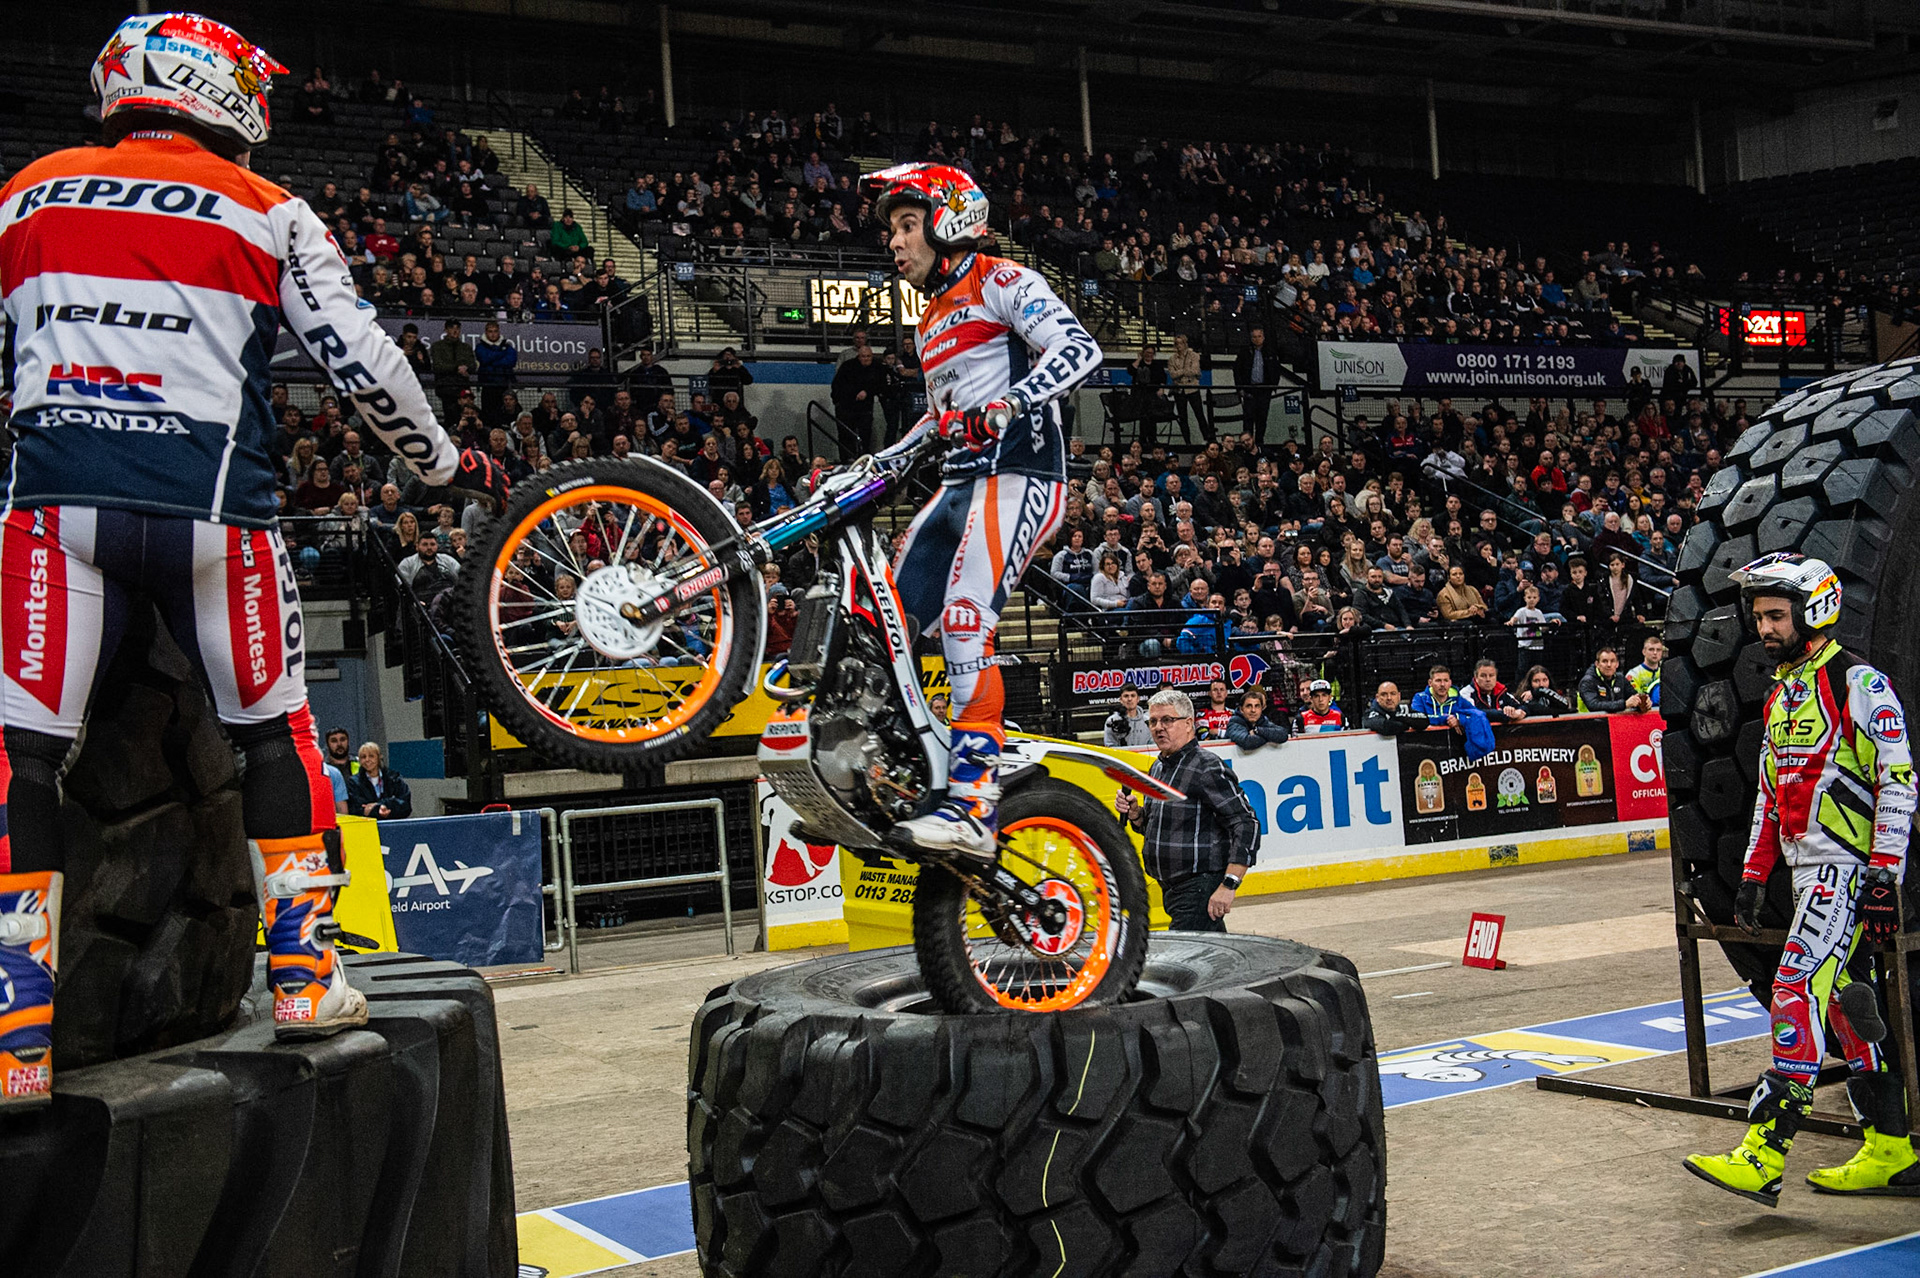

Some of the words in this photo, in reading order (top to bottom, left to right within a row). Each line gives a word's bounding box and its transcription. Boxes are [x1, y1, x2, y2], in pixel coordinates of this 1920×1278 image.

[167, 41, 215, 65] SPEA
[167, 63, 263, 140] hebo
[131, 131, 174, 140] hebo
[15, 179, 223, 220] REPSOL
[678, 266, 693, 274] 217
[510, 335, 587, 354] olutions
[1024, 315, 1094, 396] REPSOL
[1334, 360, 1385, 374] UNISON
[1456, 353, 1498, 368] 0800
[1503, 354, 1531, 369] 171
[1536, 355, 1576, 370] 2193
[692, 380, 707, 389] 117
[1426, 369, 1607, 387] www.join.unison.org.uk
[303, 323, 440, 477] REPSOL
[35, 407, 190, 435] HONDA
[1001, 475, 1049, 598] REPSOL
[19, 548, 49, 682] Montesa
[871, 581, 905, 659] REPSOL
[242, 573, 268, 686] Montesa
[1072, 662, 1225, 693] ROADANDTRIALS
[1439, 750, 1512, 775] BRADFIELD
[1514, 748, 1576, 763] BREWERY
[1632, 788, 1667, 799] OFFICIAL
[859, 871, 886, 882] WASTE
[854, 884, 885, 900] 0113
[411, 900, 451, 912] Airport
[1822, 868, 1850, 945] MOTORCYCLES
[1467, 920, 1500, 960] END
[1780, 949, 1822, 974] ILS
